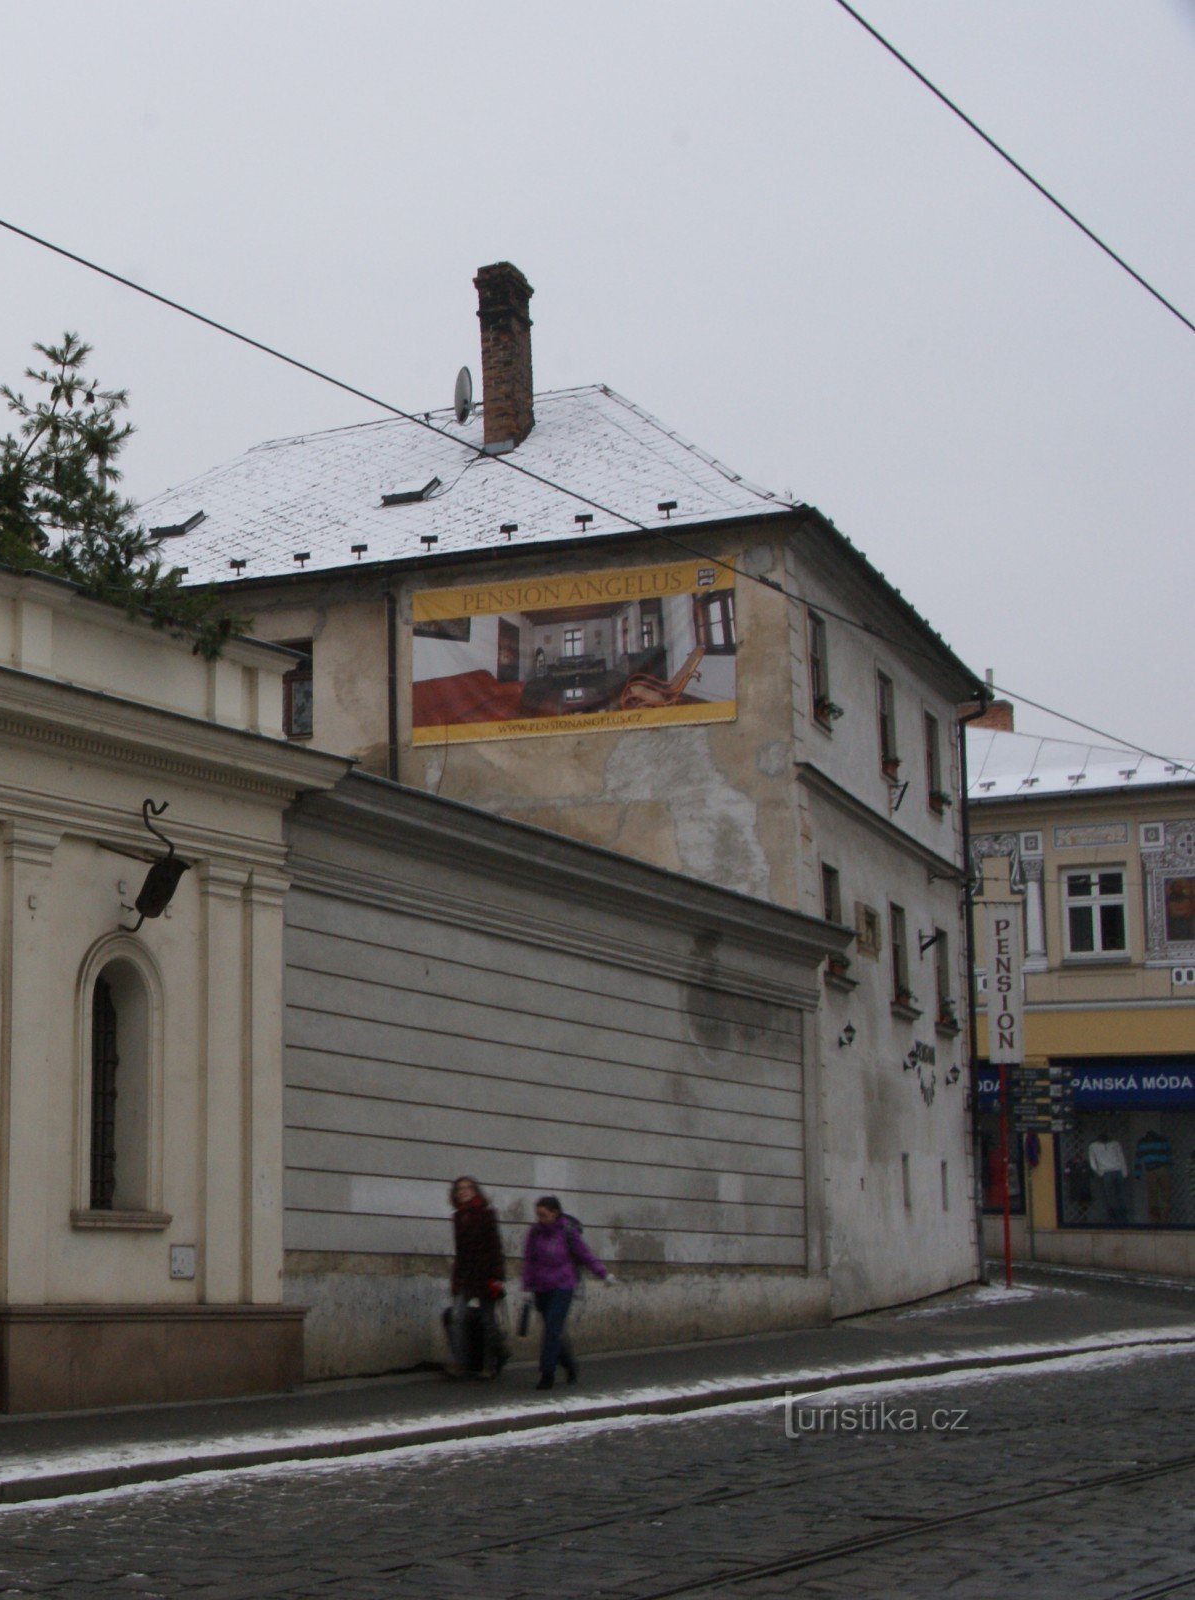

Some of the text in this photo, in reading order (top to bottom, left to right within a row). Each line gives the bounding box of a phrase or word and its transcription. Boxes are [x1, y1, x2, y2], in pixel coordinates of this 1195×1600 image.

[462, 571, 682, 611] PENSION ANGELUS
[994, 919, 1015, 1049] PENSION
[1142, 1073, 1193, 1090] MÓDA
